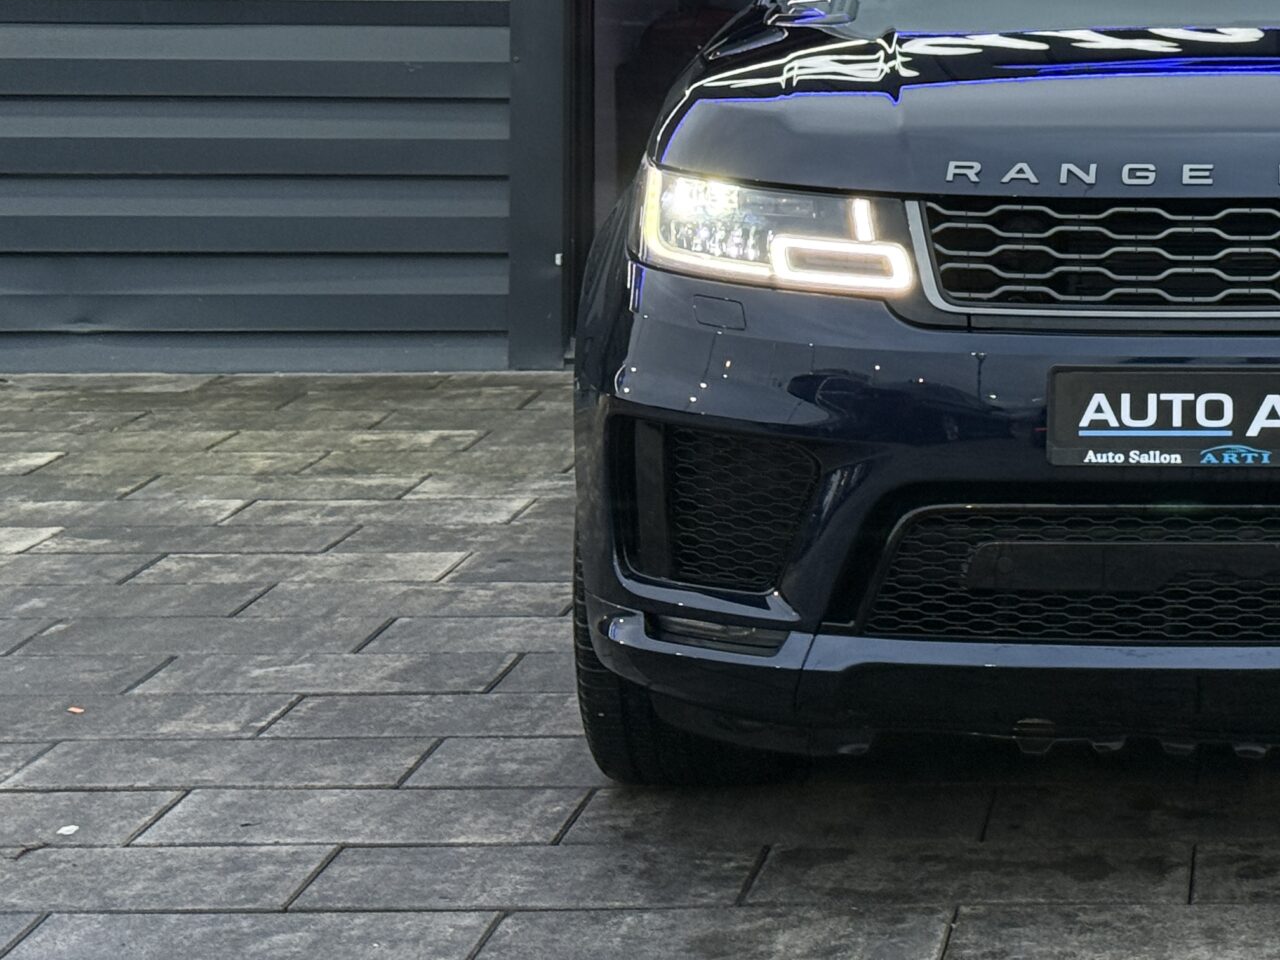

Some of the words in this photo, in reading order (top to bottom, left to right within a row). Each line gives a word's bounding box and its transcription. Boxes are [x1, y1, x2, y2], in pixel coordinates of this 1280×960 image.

[945, 160, 1215, 185] RANGE
[1078, 393, 1234, 428] AUTO
[1083, 449, 1125, 463] Auto
[1128, 449, 1183, 464] Sallon
[1200, 452, 1271, 464] ARTI
